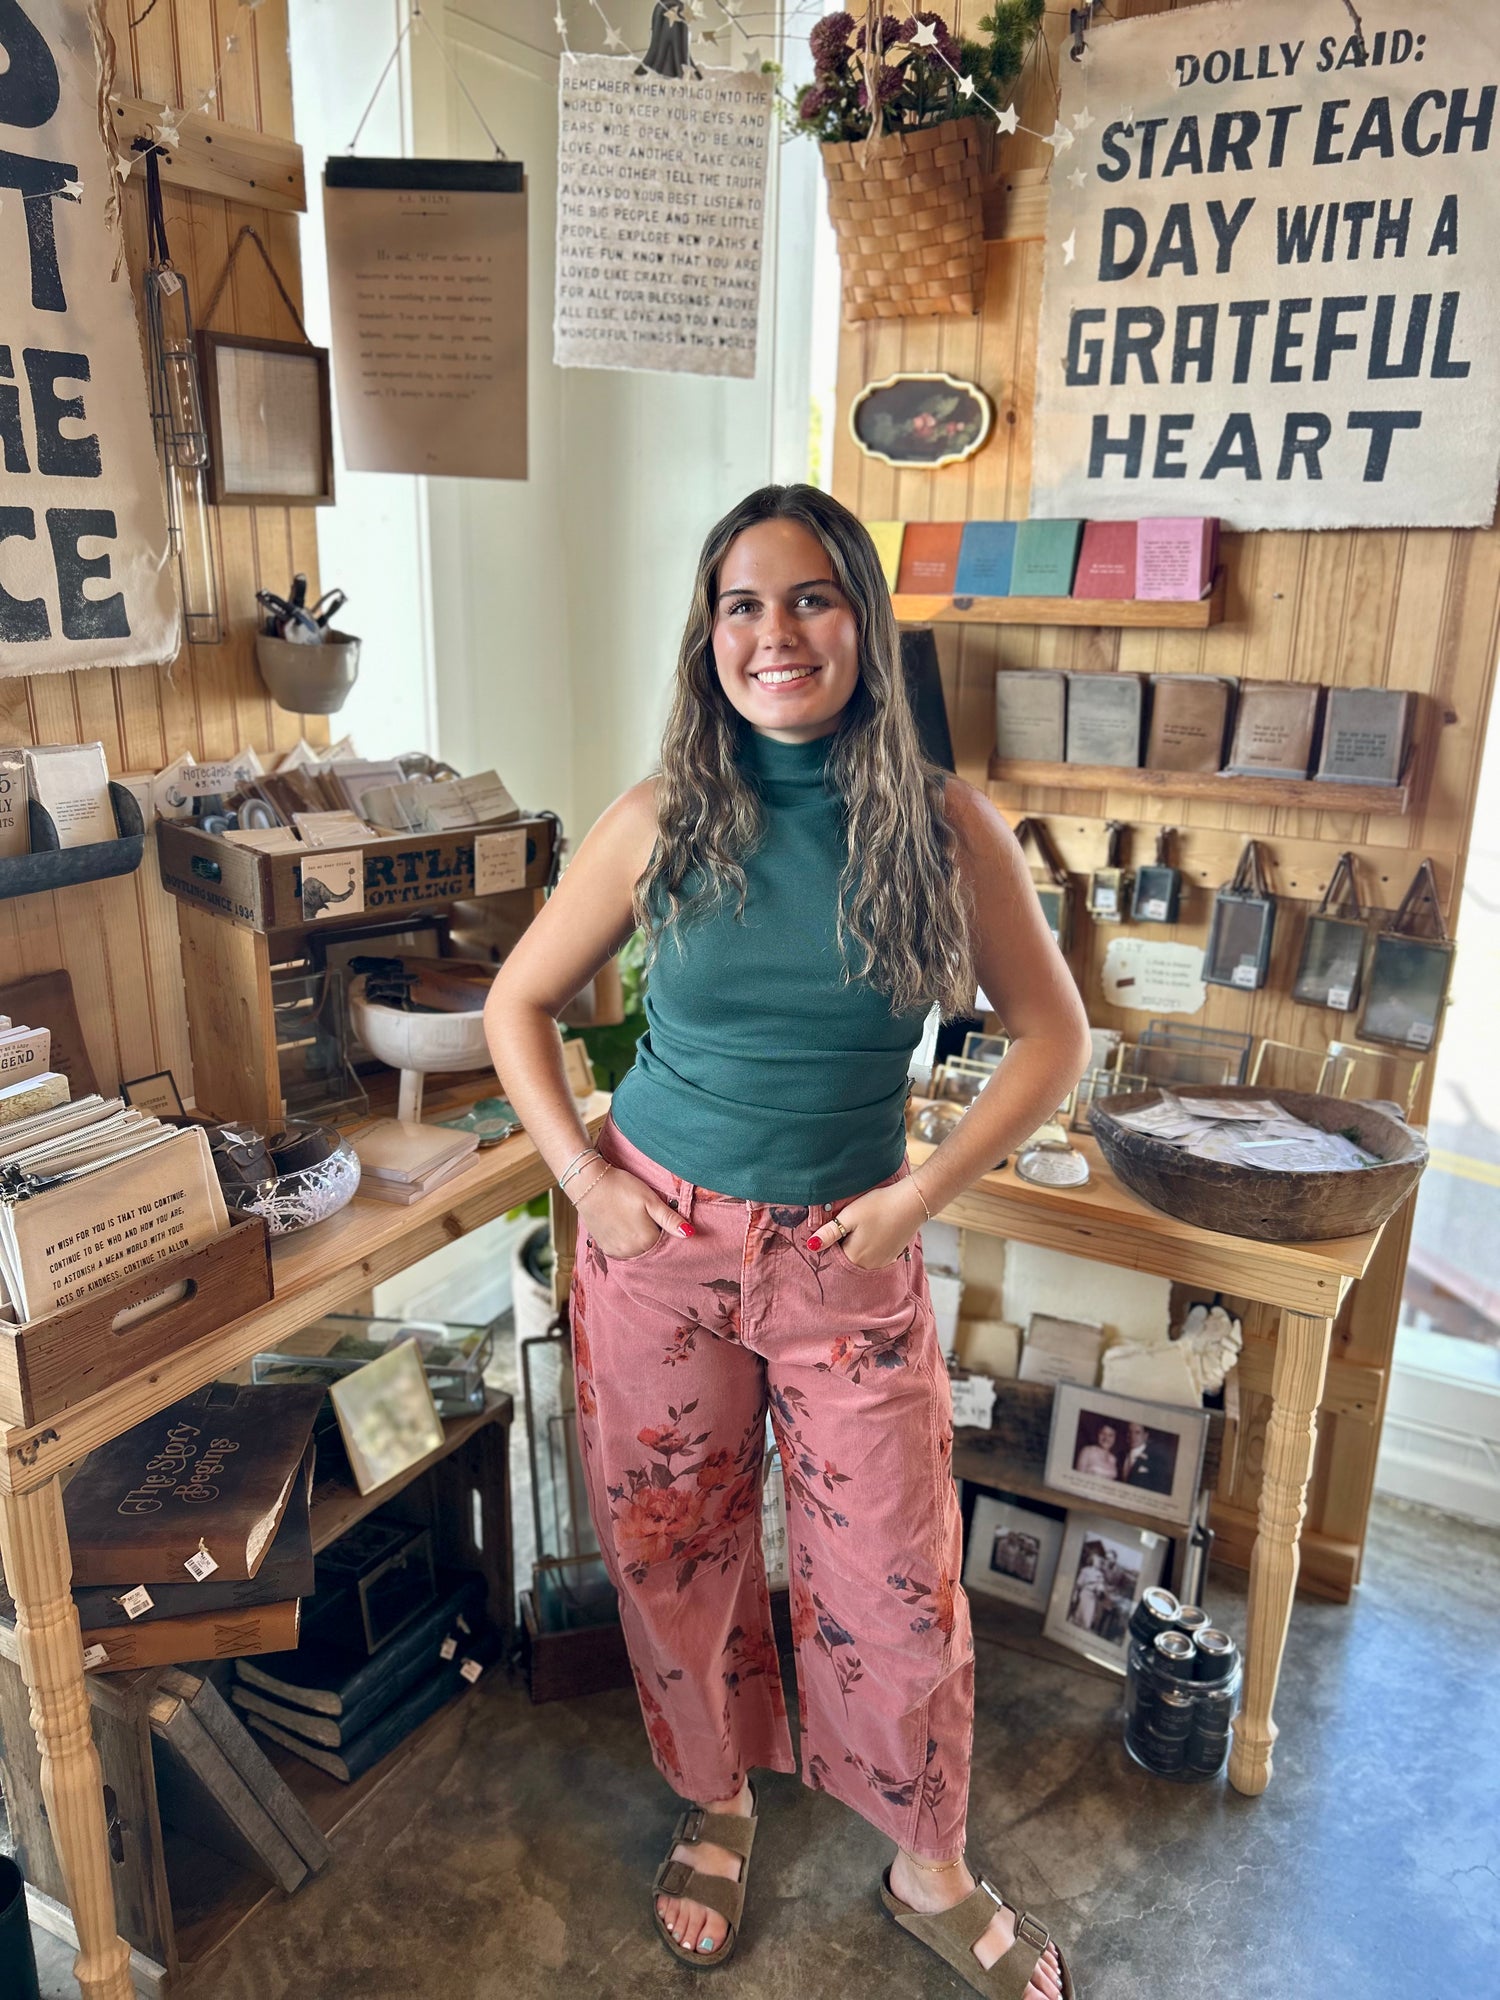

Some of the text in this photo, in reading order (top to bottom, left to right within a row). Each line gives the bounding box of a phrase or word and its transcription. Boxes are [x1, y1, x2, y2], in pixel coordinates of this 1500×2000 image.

[1175, 29, 1426, 87] DOLLY SAID:
[563, 78, 630, 94] REMEMBER
[635, 84, 665, 96] WHEN
[697, 88, 710, 99] GO
[716, 90, 741, 101] INTO
[746, 93, 767, 104] THE
[564, 101, 764, 127] WORLD TO KEEP YOUR EYES AND
[563, 121, 594, 133] EARS
[604, 125, 629, 136] WIDE
[714, 134, 728, 145] BE
[1097, 85, 1498, 182] START EACH
[562, 143, 592, 154] LOVE
[599, 145, 622, 156] ONE
[694, 153, 723, 165] TAKE
[731, 156, 761, 168] CARE
[562, 163, 573, 173] OF
[582, 164, 613, 176] EACH
[666, 170, 693, 184] TELL
[700, 174, 719, 186] THE
[562, 185, 610, 197] ALWAYS
[615, 188, 629, 199] DO
[635, 190, 664, 202] YOUR
[705, 195, 742, 208] LISTEN
[749, 198, 761, 211] TO
[563, 204, 759, 229] THE BIG PEOPLE AND THE LITTLE
[619, 230, 670, 244] EXPLORE
[678, 234, 701, 245] NEW
[708, 236, 746, 249] PATHS
[753, 240, 759, 250] &
[1098, 194, 1458, 282] DAY WITH A
[562, 247, 593, 259] HAVE
[633, 251, 663, 263] KNOW
[671, 254, 700, 266] THAT
[707, 257, 728, 268] YOU
[735, 260, 758, 271] ARE
[562, 266, 599, 279] LOVED
[604, 269, 628, 281] LIKE
[682, 275, 708, 286] GIVE
[714, 277, 756, 290] THANKS
[561, 286, 584, 296] FOR
[588, 288, 610, 299] ALL
[615, 290, 644, 301] YOUR
[719, 298, 756, 311] ABOVE
[561, 307, 582, 318] ALL
[624, 311, 652, 321] LOVE
[658, 313, 682, 324] AND
[686, 314, 707, 326] YOU
[713, 316, 736, 328] WILL
[741, 318, 756, 329] DO
[561, 328, 628, 341] WONDERFUL
[633, 331, 673, 343] THINGS
[675, 336, 686, 344] IN
[691, 335, 714, 347] THIS
[1066, 291, 1471, 387] GRATEFUL
[1087, 410, 1423, 482] HEART
[363, 880, 463, 907] OTTLING
[235, 904, 255, 922] 1934
[46, 1246, 55, 1256] MY
[58, 1237, 74, 1251] WISH
[76, 1229, 89, 1242] FOR
[92, 1222, 105, 1235] YOU
[108, 1218, 115, 1227] IS
[117, 1210, 135, 1224] THAT
[138, 1204, 152, 1216] YOU
[50, 1252, 81, 1273] CONTINUE
[84, 1247, 92, 1257] TO
[96, 1241, 104, 1252] BE
[107, 1234, 122, 1246] WHO
[125, 1228, 138, 1239] AND
[140, 1221, 154, 1233] HOW
[156, 1214, 168, 1224] YOU
[53, 1223, 184, 1290] TO ASTONISH A MEAN WORLD WITH YOUR
[56, 1294, 74, 1308] ACTS
[76, 1287, 85, 1298] OF
[124, 1254, 155, 1275] CONTINUE
[158, 1249, 166, 1258] TO
[169, 1239, 190, 1254] ALLOW
[117, 1421, 200, 1515] The Story
[172, 1438, 240, 1503] Begins
